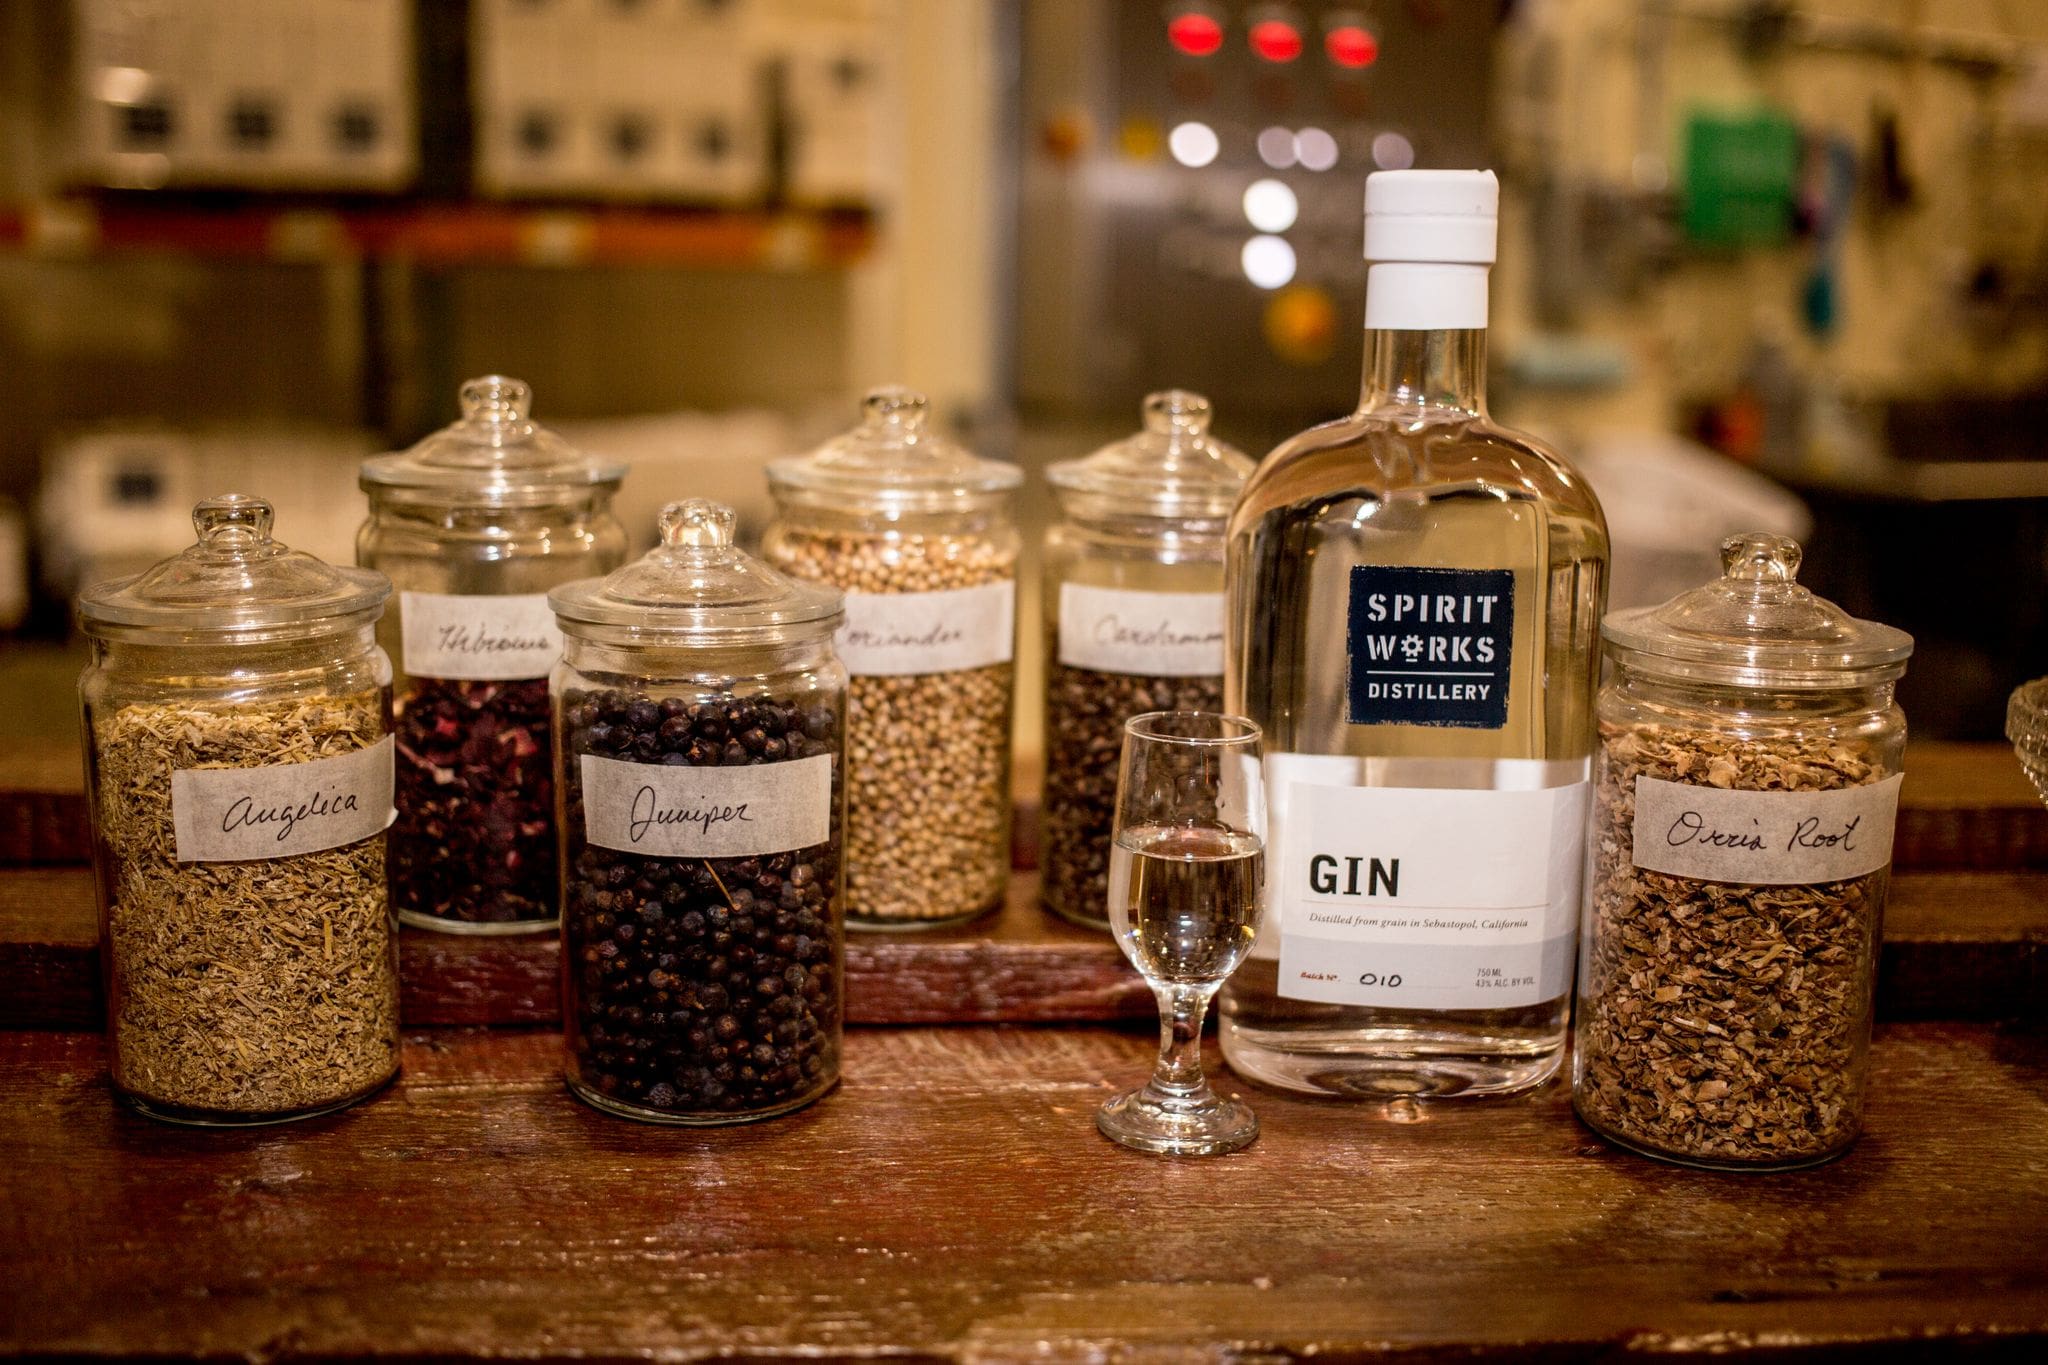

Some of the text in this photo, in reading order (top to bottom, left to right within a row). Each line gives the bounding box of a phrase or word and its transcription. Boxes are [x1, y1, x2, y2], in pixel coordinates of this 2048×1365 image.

[1367, 593, 1498, 624] SPIRIT
[846, 622, 963, 648] oriander
[1366, 634, 1495, 663] WORKS
[1368, 682, 1491, 701] DISTILLERY
[222, 785, 358, 842] Angelica
[630, 785, 753, 843] Juniper
[1666, 811, 1861, 852] Orris Root
[1309, 853, 1400, 898] GIN
[1309, 911, 1529, 932] Distilled from grain in Sebastopol, California
[1300, 970, 1324, 981] Batch
[1475, 978, 1493, 988] 43%
[1511, 978, 1521, 987] BY
